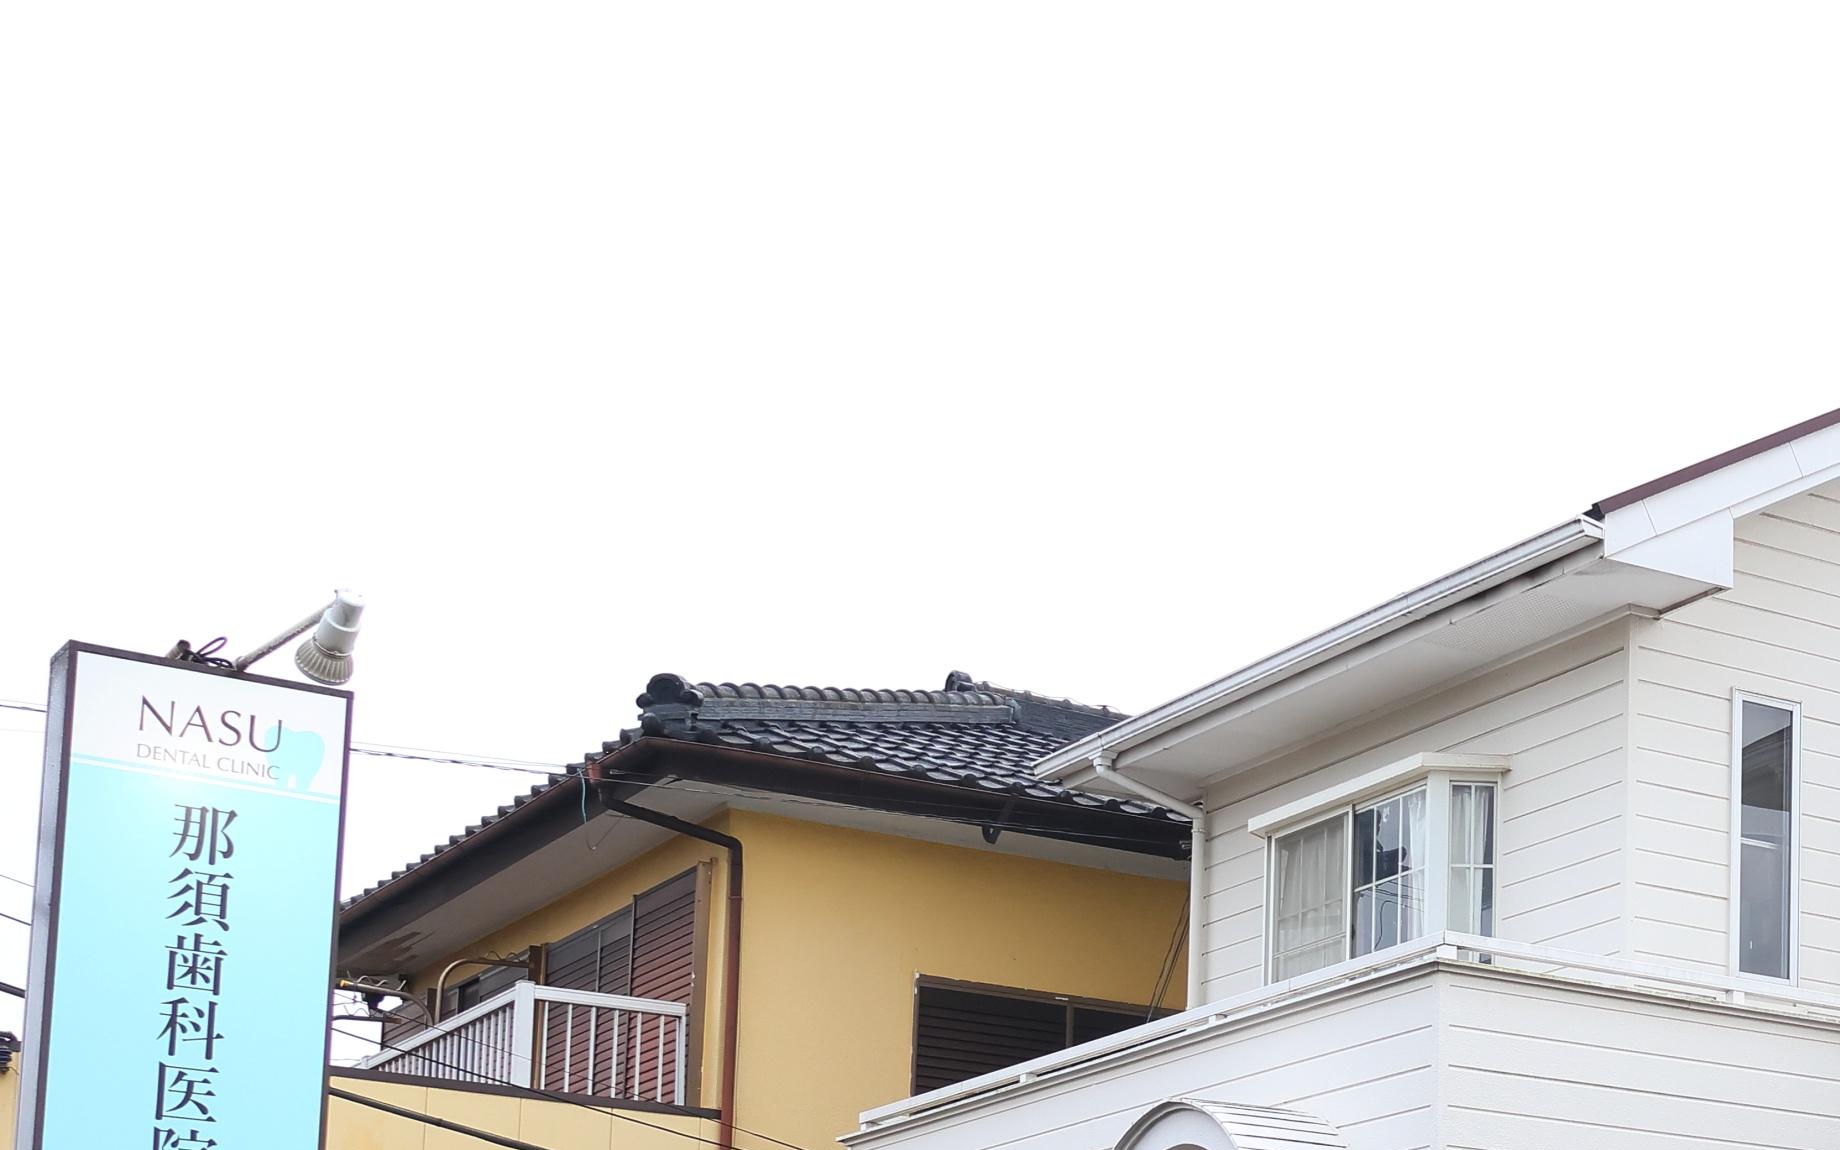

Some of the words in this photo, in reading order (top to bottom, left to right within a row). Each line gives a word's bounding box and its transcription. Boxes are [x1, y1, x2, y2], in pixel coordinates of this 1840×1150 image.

[138, 694, 283, 753] NASU
[136, 743, 211, 769] DENTAL
[216, 756, 281, 780] CLINIC
